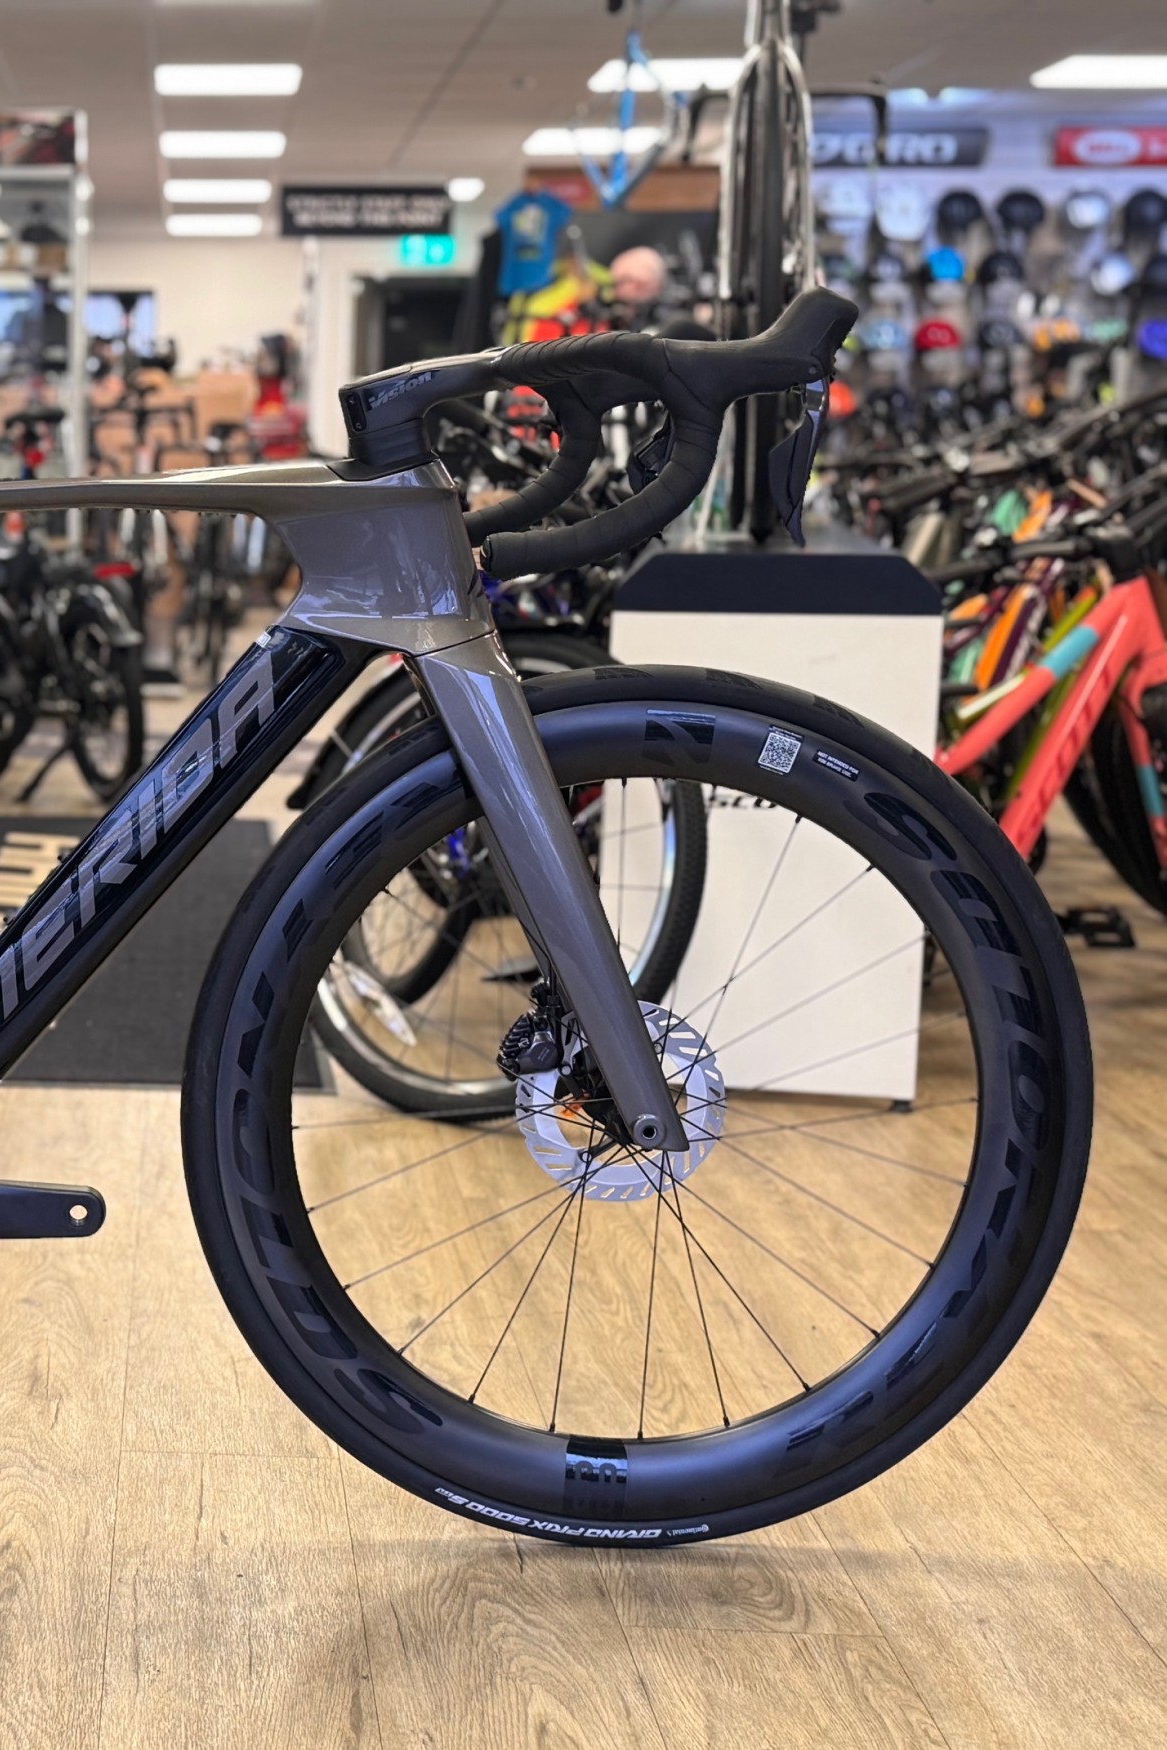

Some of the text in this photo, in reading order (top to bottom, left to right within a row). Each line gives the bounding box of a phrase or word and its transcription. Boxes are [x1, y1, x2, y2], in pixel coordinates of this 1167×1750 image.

[843, 133, 958, 164] GRO
[465, 1501, 532, 1527] 5000
[531, 1519, 586, 1537] PRIX
[584, 1528, 663, 1540] GRAND
